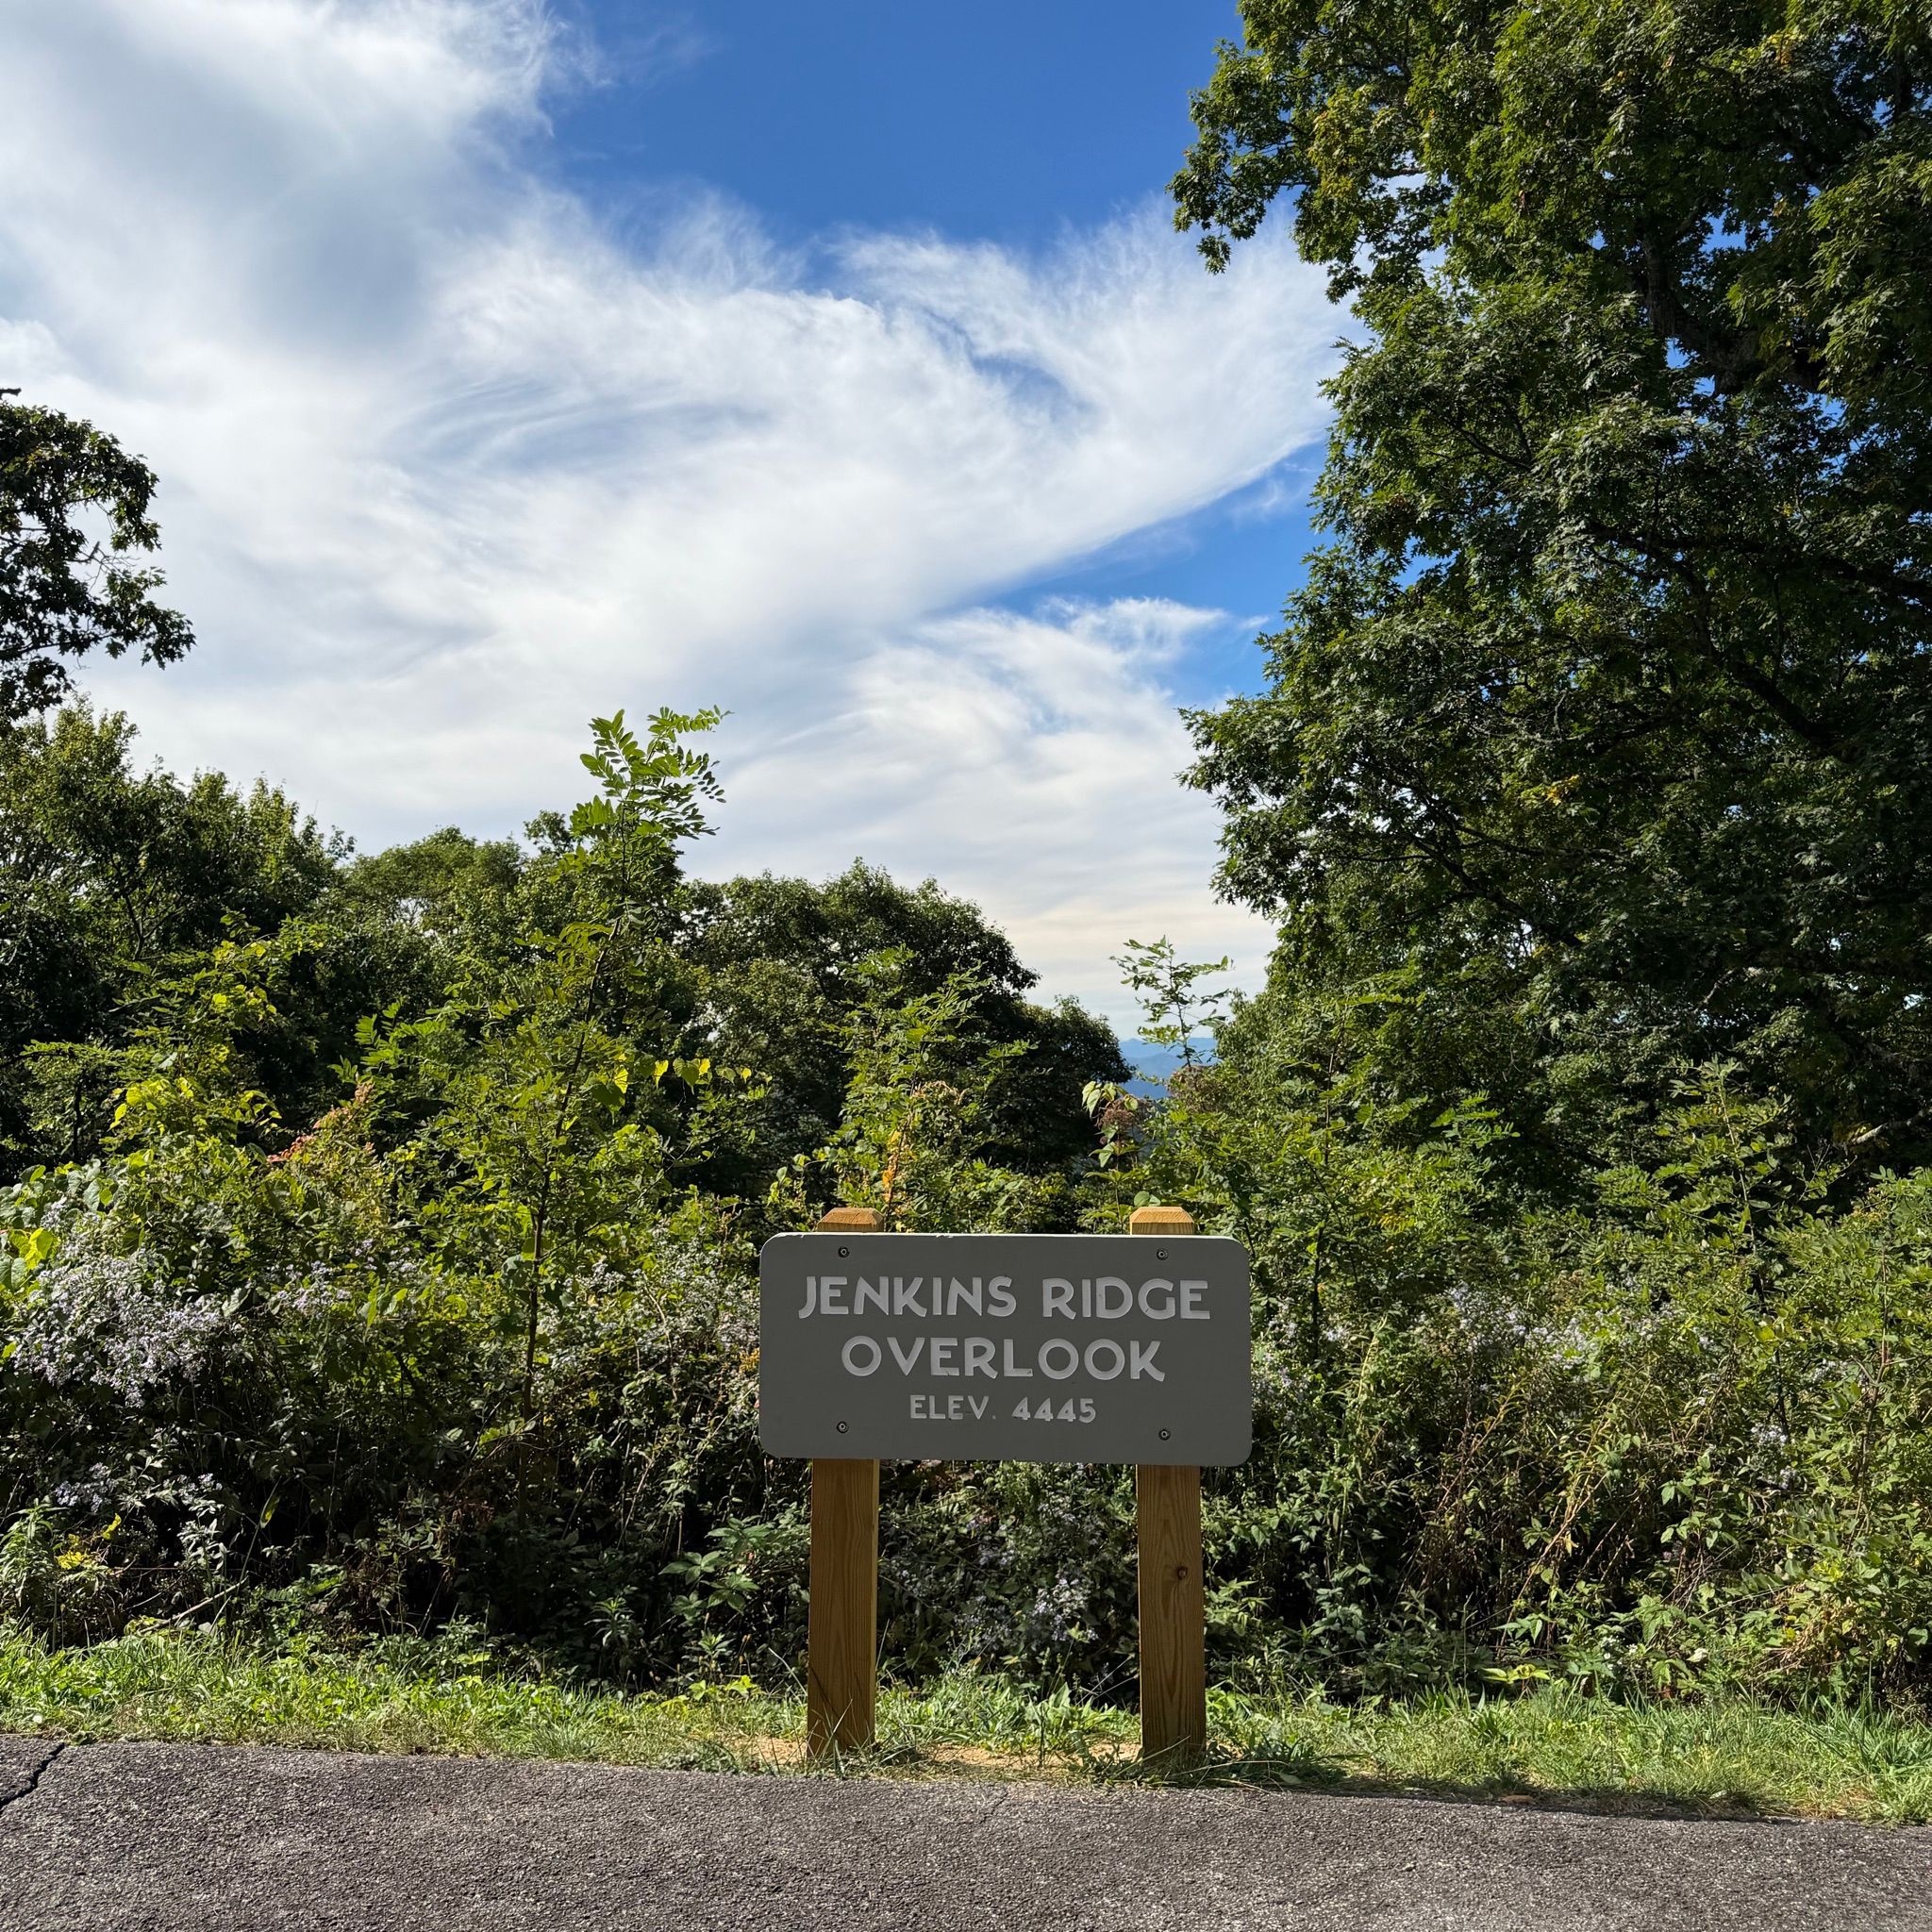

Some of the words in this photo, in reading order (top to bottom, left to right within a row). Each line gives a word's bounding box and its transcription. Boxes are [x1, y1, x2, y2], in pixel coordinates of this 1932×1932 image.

[798, 1275, 1017, 1320] JENKINS
[1042, 1276, 1210, 1320] RIDGE
[841, 1335, 1166, 1382] OVERLOOK
[909, 1394, 997, 1420] ELEV.
[1011, 1396, 1096, 1424] 4445
